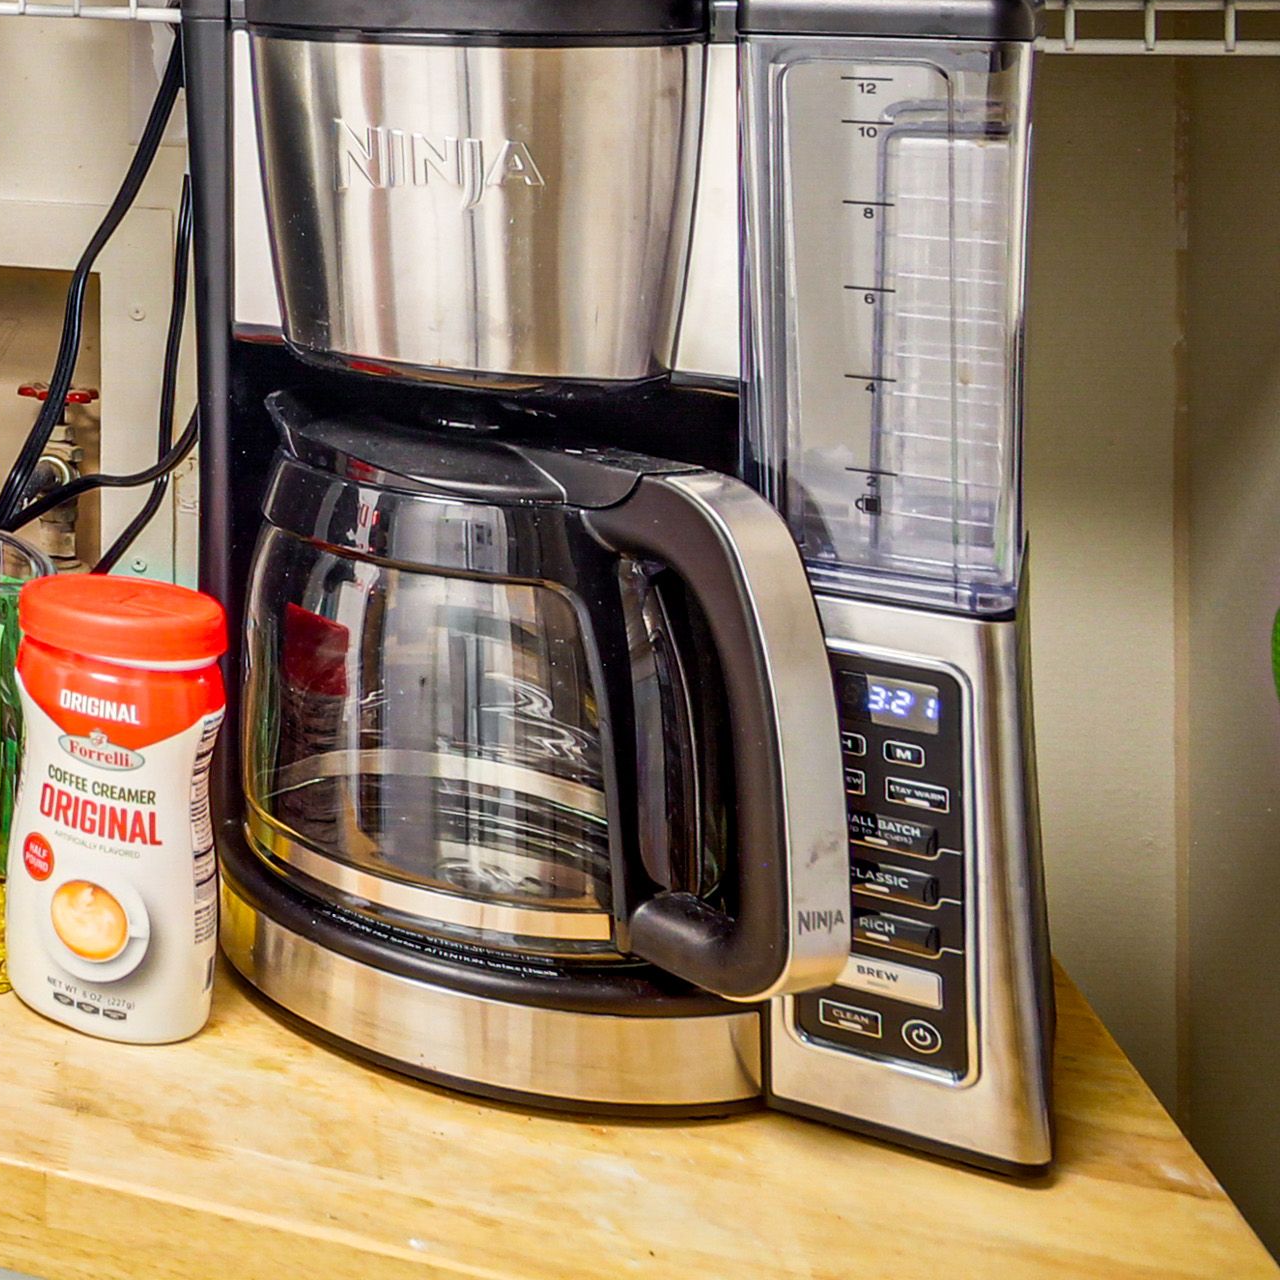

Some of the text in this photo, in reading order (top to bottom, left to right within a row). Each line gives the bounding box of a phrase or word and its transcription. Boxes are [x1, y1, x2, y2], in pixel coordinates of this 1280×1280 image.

[857, 83, 877, 95] 12
[858, 126, 878, 138] 10
[334, 117, 545, 211] NINJA
[863, 207, 874, 219] 8
[863, 293, 875, 304] 6
[865, 383, 877, 394] 4
[866, 476, 877, 487] 2
[60, 688, 140, 726] ORIGINAL
[868, 685, 939, 719] 3:21
[895, 748, 912, 761] M
[48, 763, 157, 806] COFFEE CREAMER
[890, 784, 946, 802] STAY WARM
[39, 783, 163, 847] ORIGINAL
[878, 819, 921, 837] BATCH
[29, 841, 49, 860] HALF
[99, 844, 141, 860] FLAVORED
[25, 851, 49, 873] POUND
[797, 910, 845, 935] NINJA
[860, 916, 896, 935] RICH
[857, 965, 899, 983] BREW
[832, 1009, 870, 1025] CLEAN
